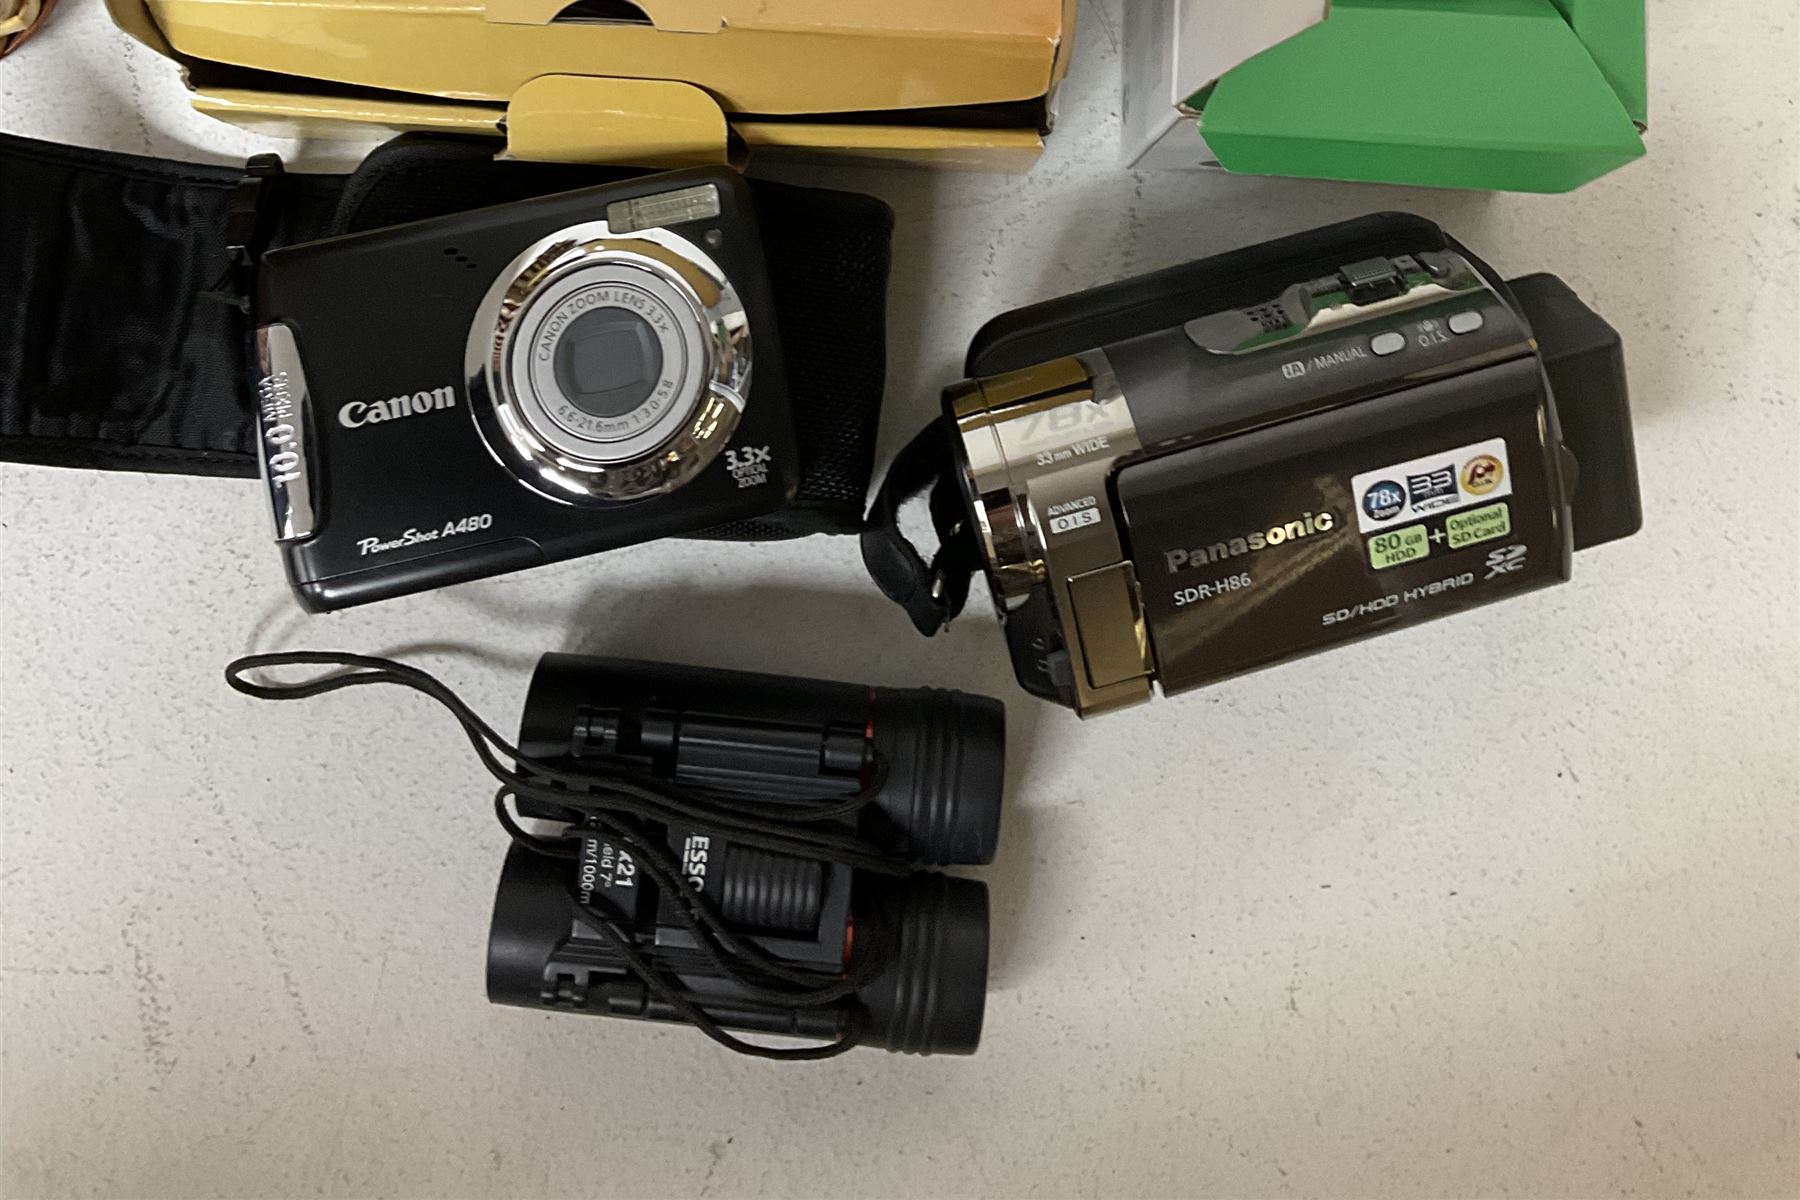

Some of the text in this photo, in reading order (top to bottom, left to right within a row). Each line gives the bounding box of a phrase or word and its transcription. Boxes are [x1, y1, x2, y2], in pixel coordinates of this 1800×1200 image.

[538, 312, 569, 361] CANON
[567, 291, 610, 312] ZOOM
[614, 291, 646, 309] LENS
[338, 385, 456, 429] Canon
[265, 424, 302, 488] 10.0
[1071, 434, 1110, 456] WIDE
[1410, 470, 1453, 495] 33
[1047, 495, 1097, 516] ADVANCED
[1367, 488, 1402, 509] 78x
[1450, 507, 1503, 531] Optional
[356, 513, 493, 556] PowerShot A480
[1164, 512, 1334, 574] Panasonic
[1374, 533, 1423, 554] 80 GB
[1452, 521, 1507, 545] SD Card
[1385, 546, 1417, 564] HDD
[1174, 572, 1252, 606] SDR-H86
[1322, 572, 1475, 626] SD/HDD HYBRID
